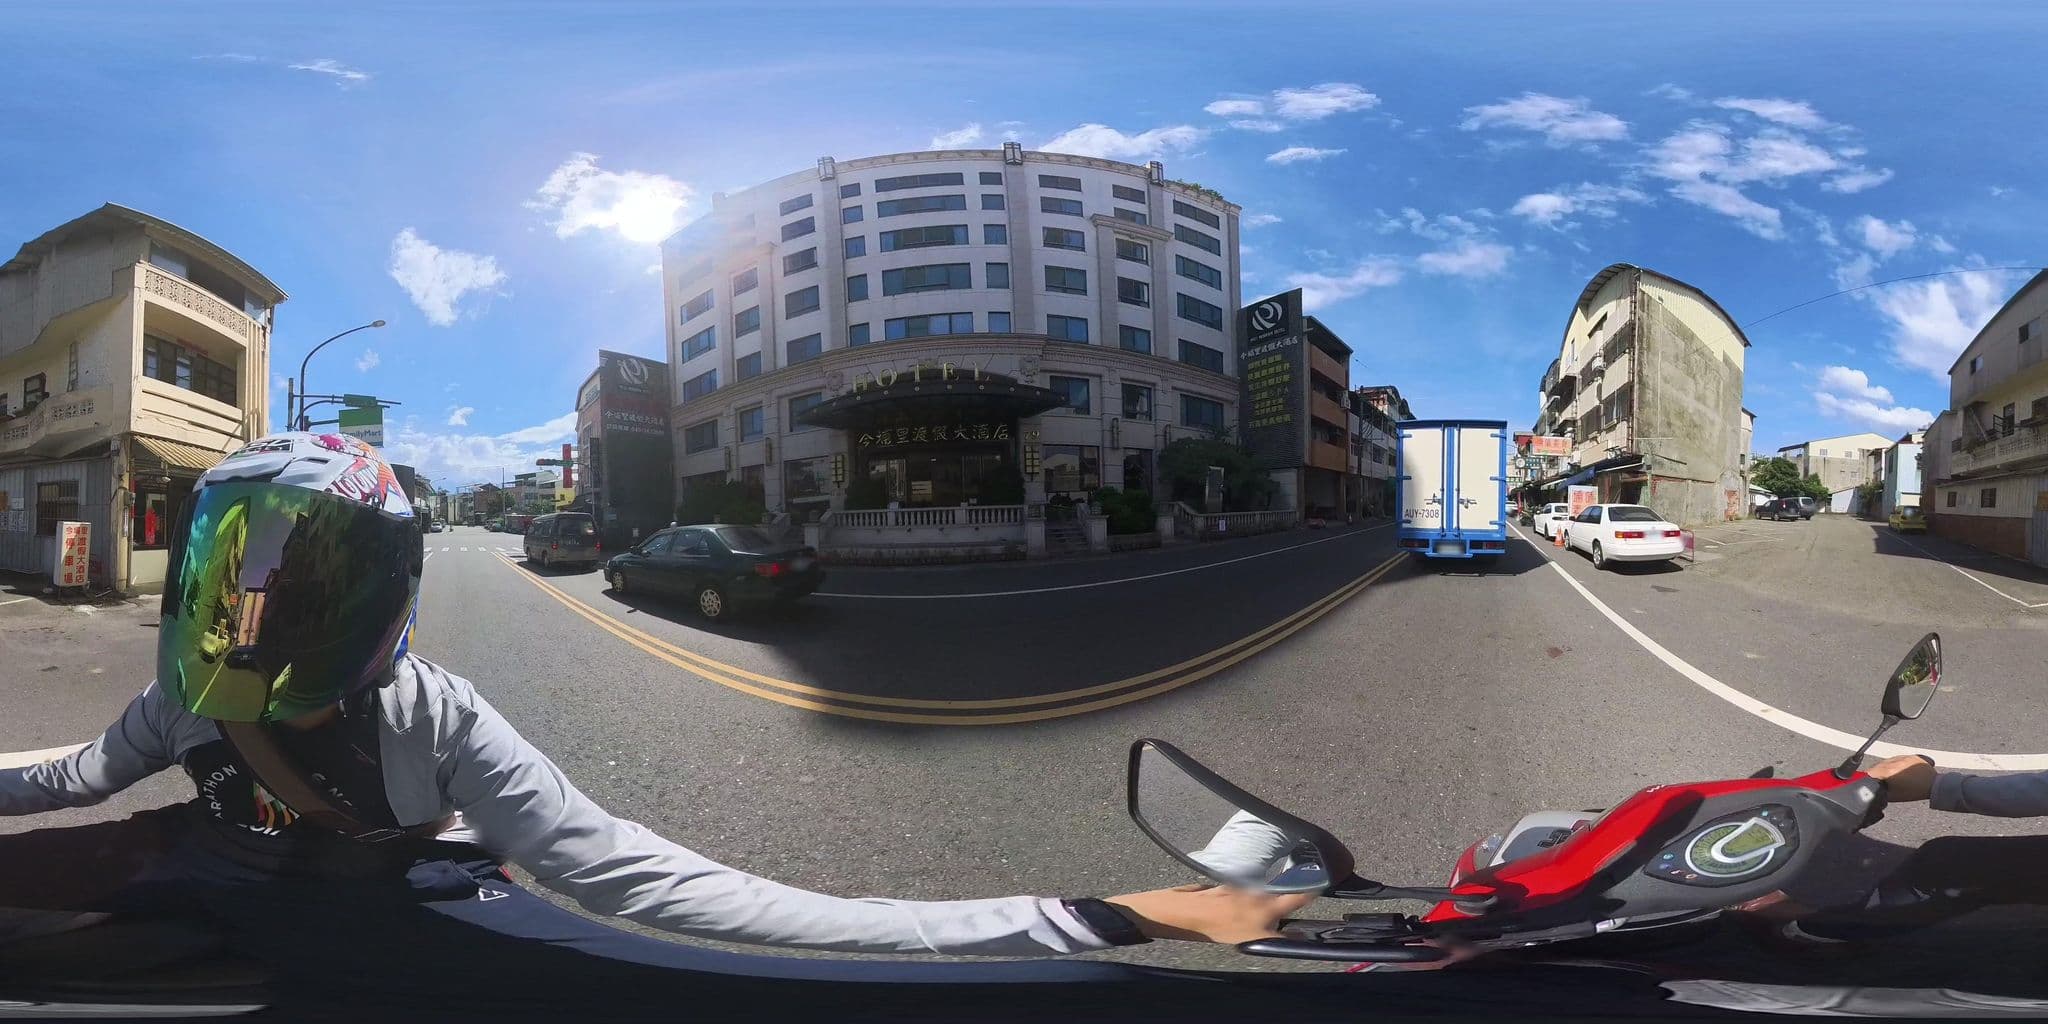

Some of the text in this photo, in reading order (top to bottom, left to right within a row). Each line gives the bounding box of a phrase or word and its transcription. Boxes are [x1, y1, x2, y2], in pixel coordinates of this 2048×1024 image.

[853, 361, 991, 393] HOTEL
[340, 430, 381, 439] milyMart
[1404, 508, 1440, 518] AUY-7308
[203, 764, 238, 820] ARATHON
